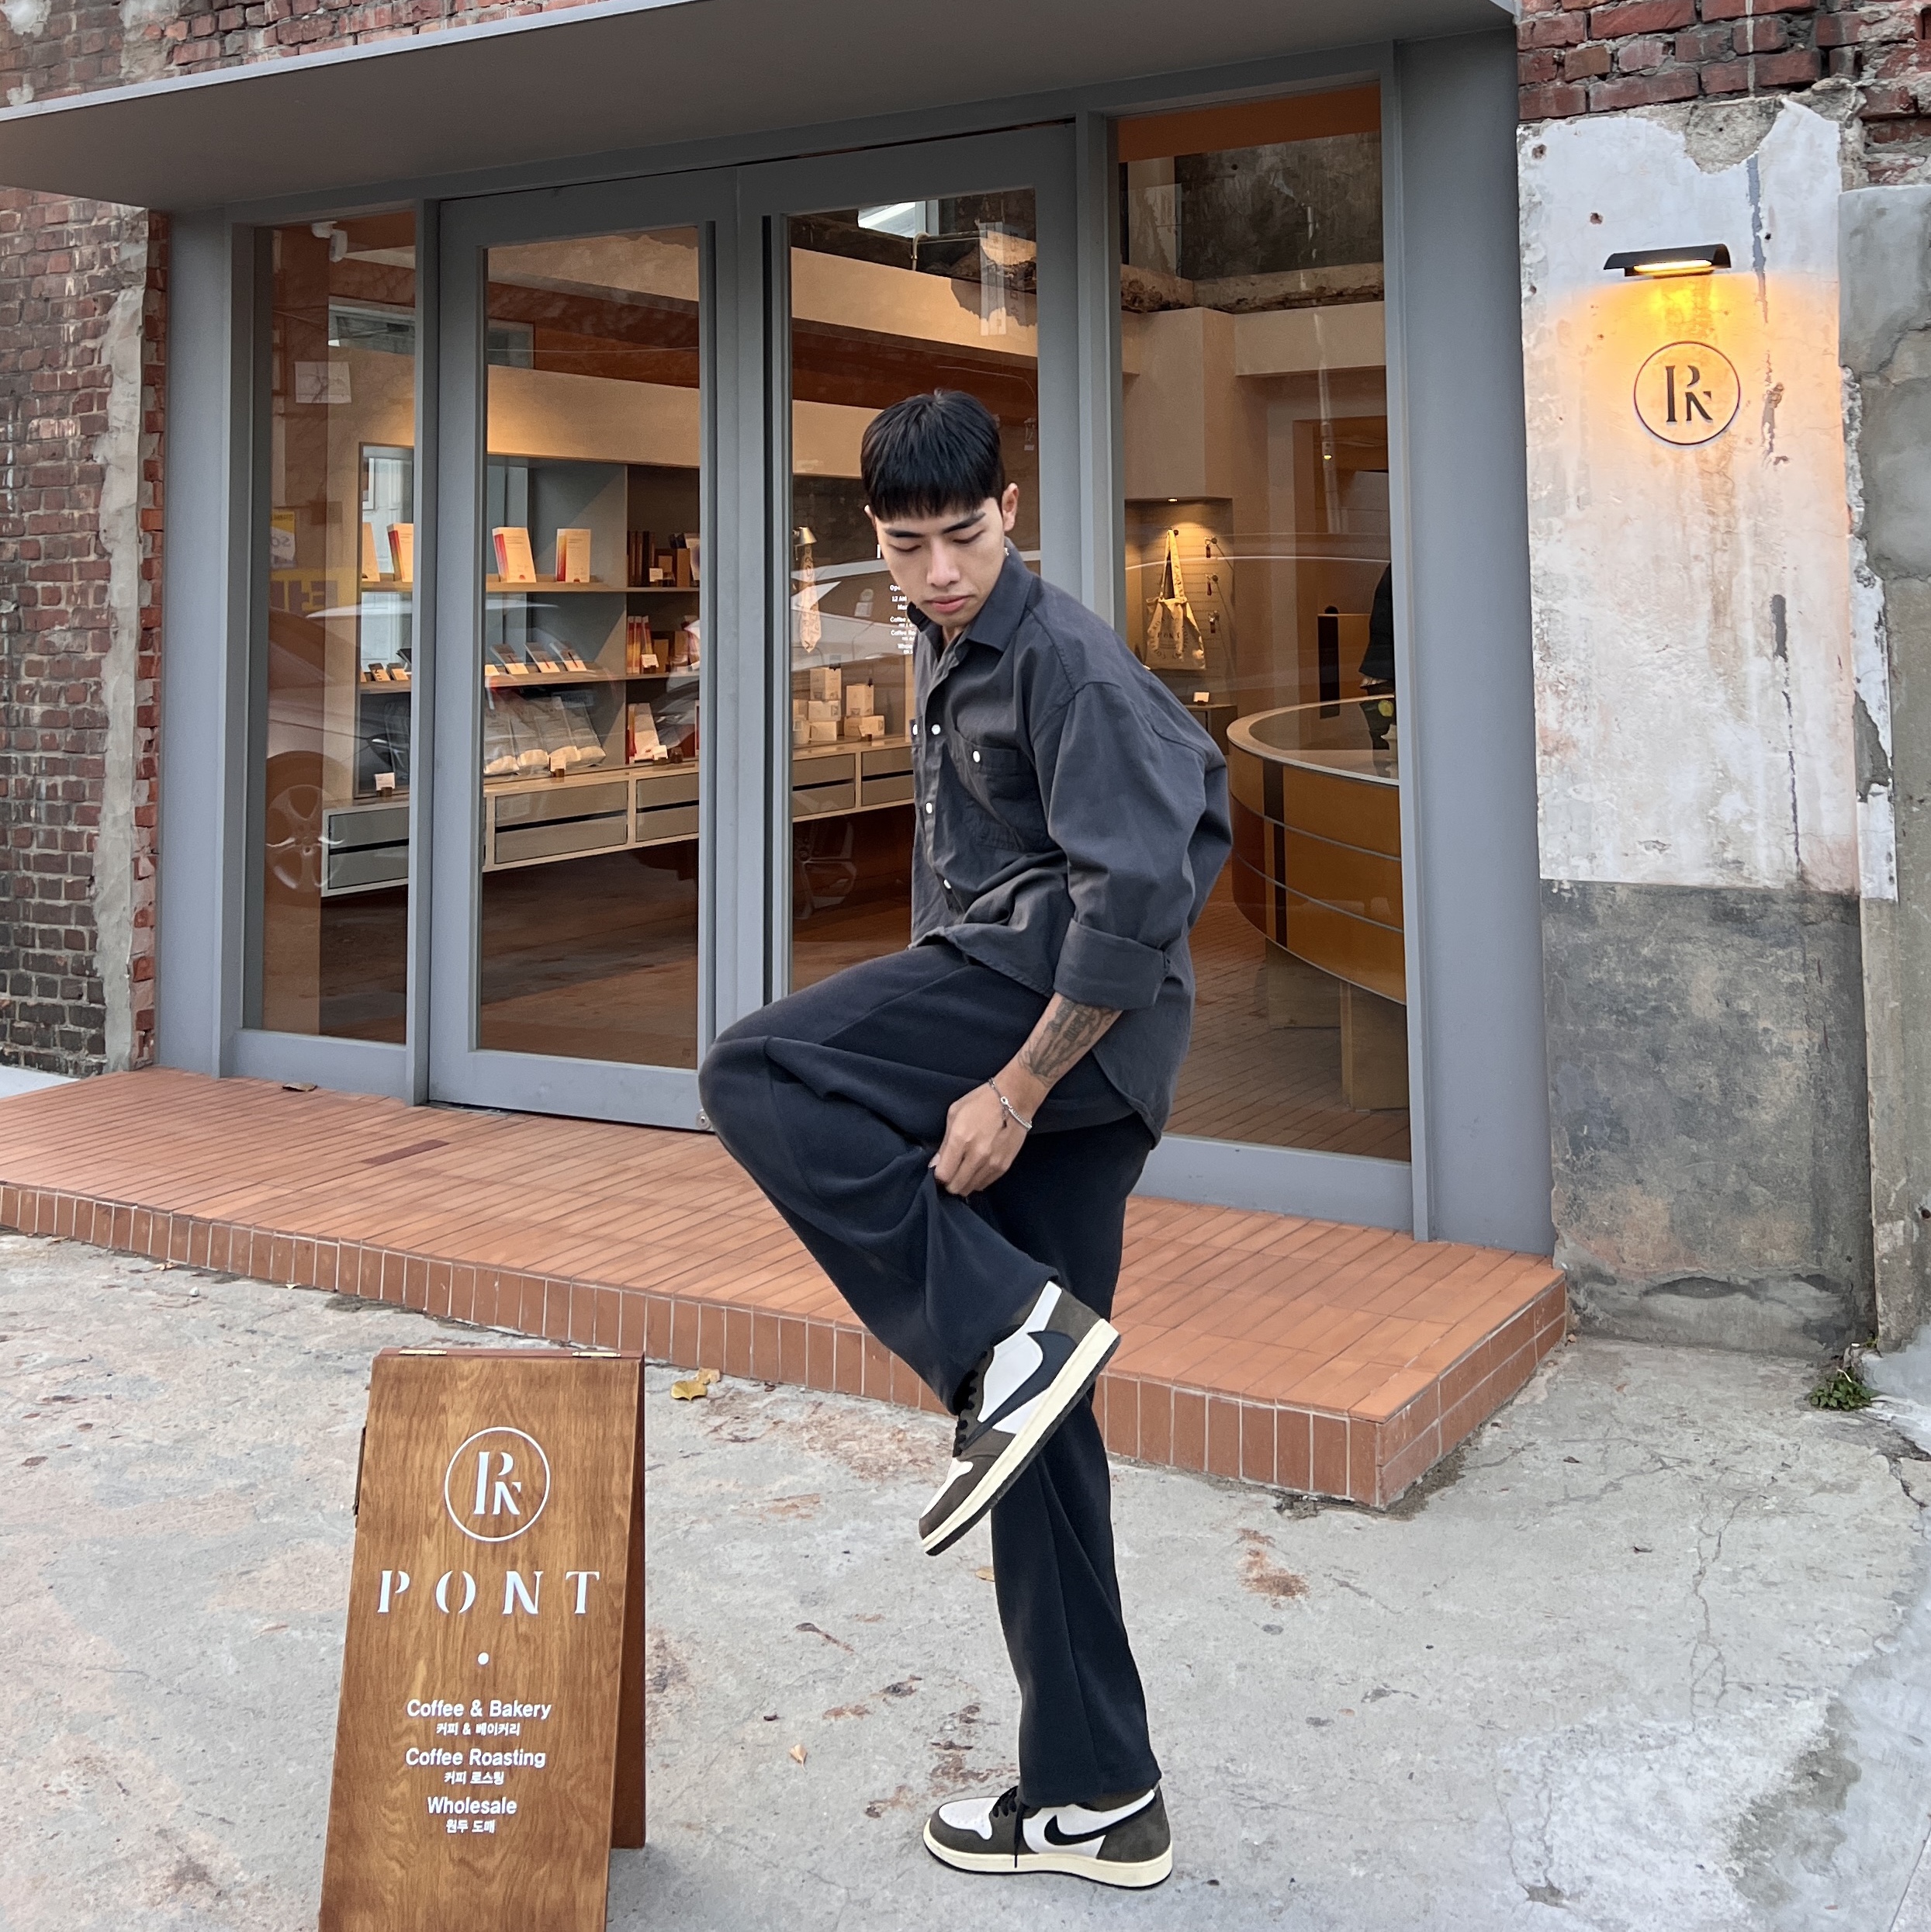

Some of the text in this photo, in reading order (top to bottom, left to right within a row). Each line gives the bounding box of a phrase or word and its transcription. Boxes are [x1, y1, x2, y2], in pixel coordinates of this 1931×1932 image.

[377, 1570, 600, 1615] PONT
[407, 1698, 552, 1720] Coffee & Bakery
[436, 1722, 521, 1736] 커피 & 베이커리
[405, 1747, 546, 1769] Coffee Roasting
[444, 1770, 504, 1785] 커피 로스팅
[427, 1796, 517, 1815] Wholesale
[445, 1819, 496, 1833] 원두 도매
